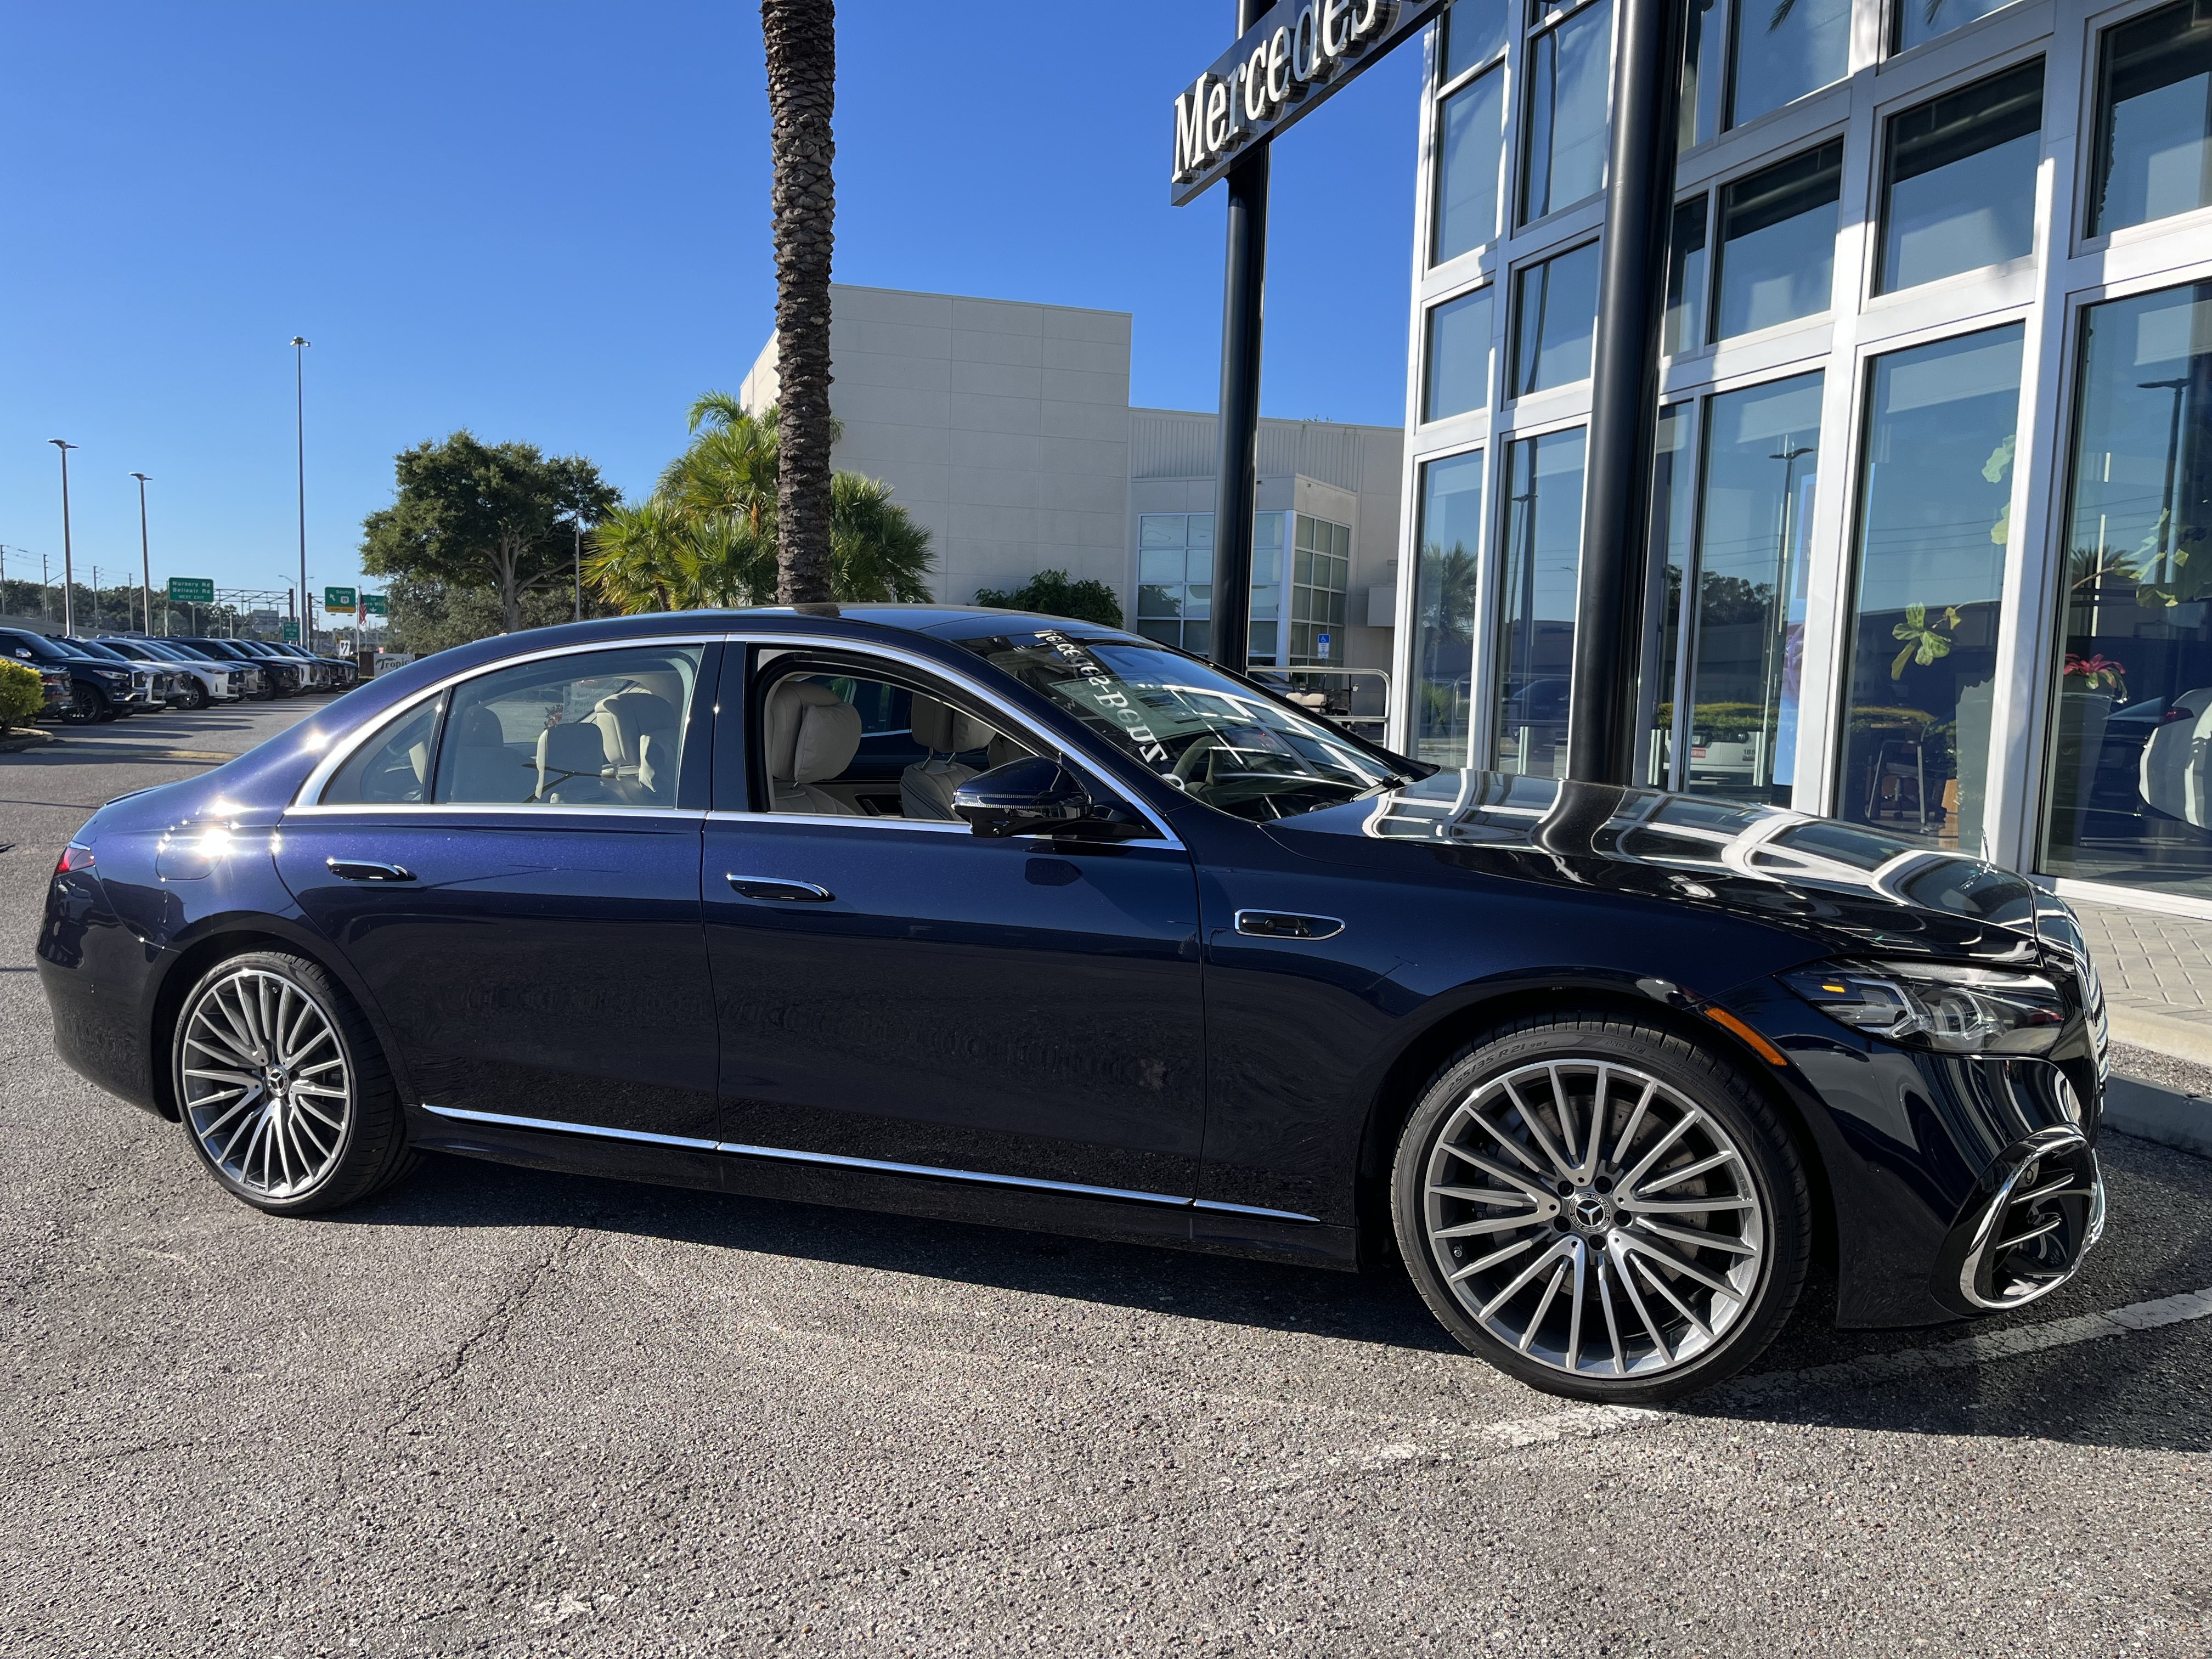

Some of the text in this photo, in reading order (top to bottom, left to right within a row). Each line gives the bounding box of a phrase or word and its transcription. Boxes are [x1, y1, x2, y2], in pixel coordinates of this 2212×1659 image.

[375, 657, 411, 670] Tropic
[1448, 1054, 1494, 1093] 255/35
[1590, 1194, 1610, 1217] MERCEDES
[1571, 1215, 1583, 1228] BENZ
